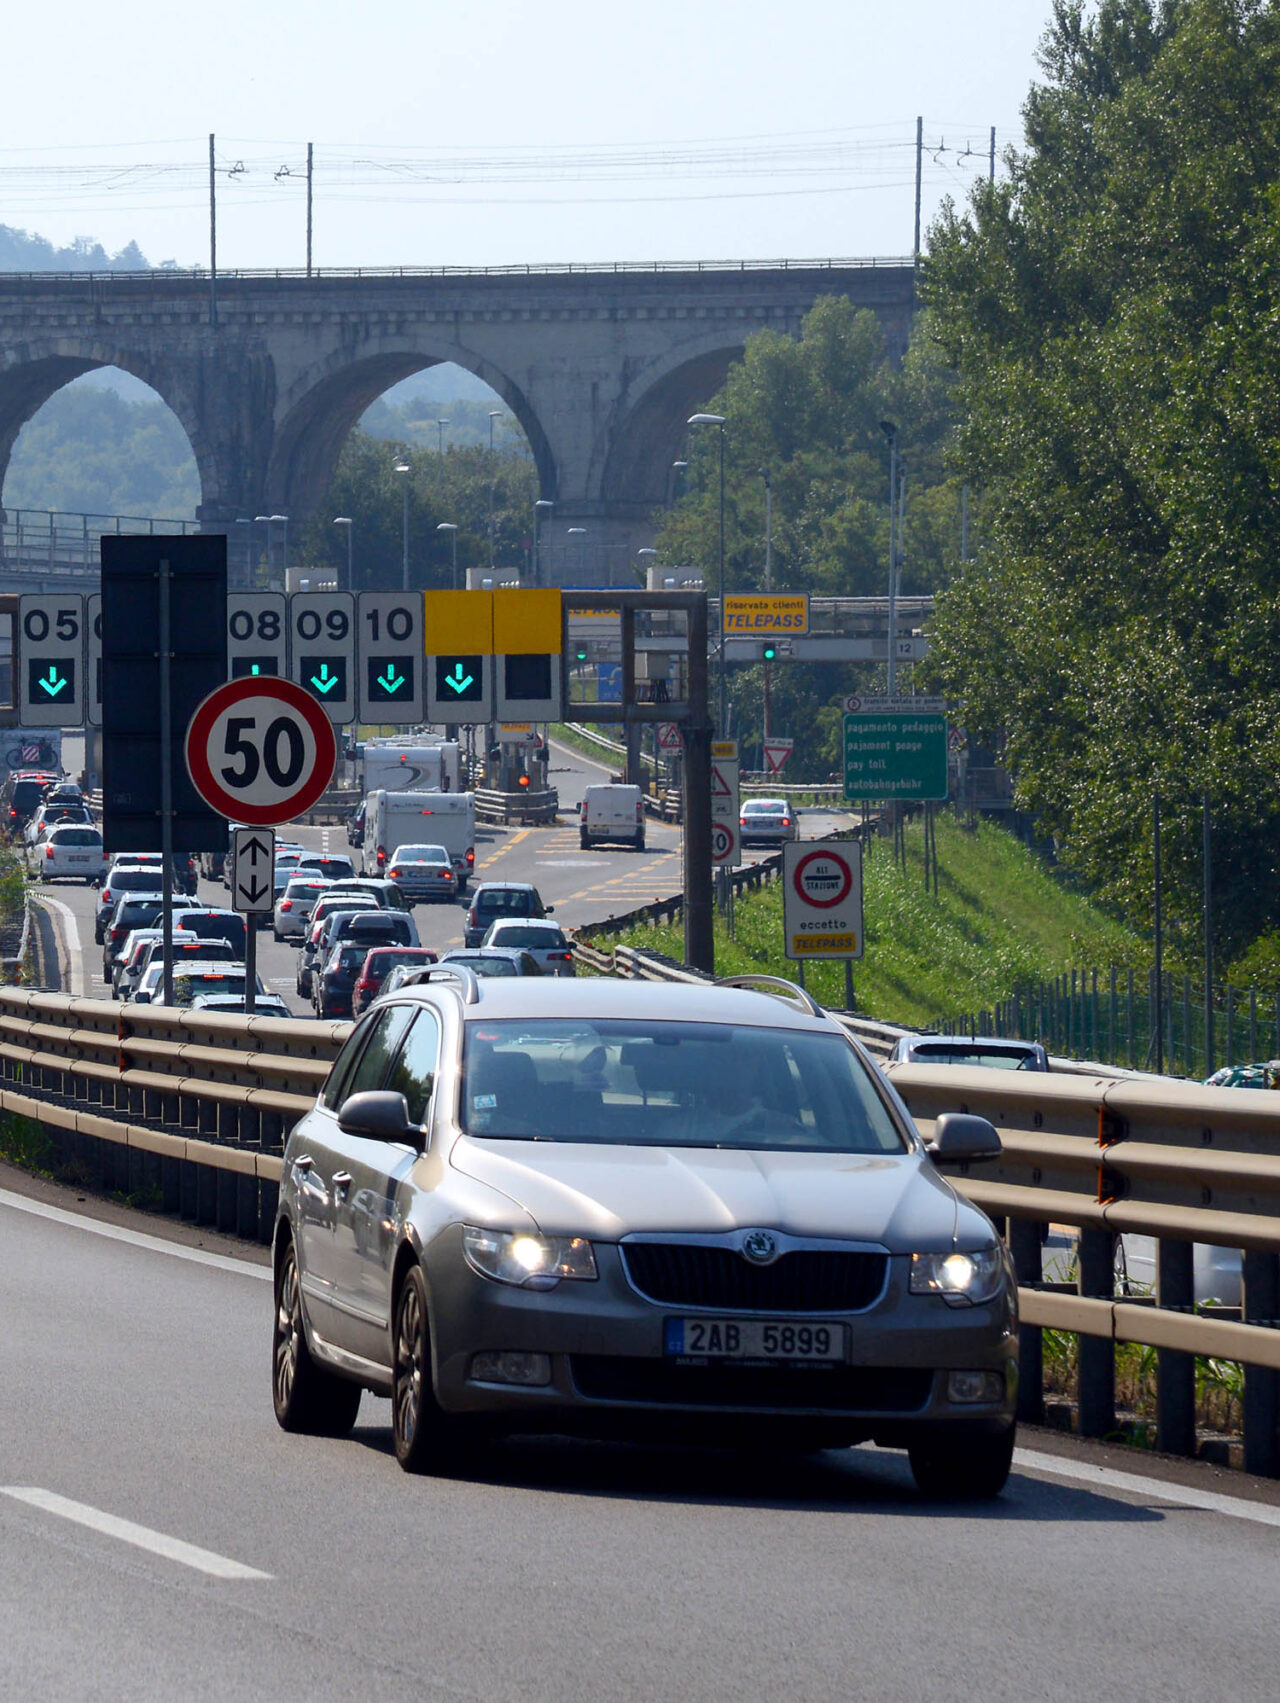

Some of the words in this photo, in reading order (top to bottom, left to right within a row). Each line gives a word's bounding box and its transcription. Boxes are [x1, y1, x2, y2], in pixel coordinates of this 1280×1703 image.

[726, 600, 769, 609] riservata
[772, 600, 804, 609] clienti
[23, 609, 80, 642] 05
[229, 610, 281, 641] 08
[296, 609, 349, 641] 09
[366, 607, 413, 641] 10
[726, 614, 804, 628] TELEPASS
[899, 643, 912, 653] 12
[847, 722, 897, 734] pagamento
[901, 721, 944, 734] pedaggio
[222, 716, 305, 788] 50
[847, 761, 864, 771] pay
[868, 759, 887, 769] toll
[815, 866, 829, 874] ALT
[806, 881, 839, 890] STAZIONE
[800, 919, 847, 930] eccetto
[794, 937, 853, 949] TELEPASS
[690, 1324, 741, 1353] 2AB
[763, 1325, 831, 1355] 5899
